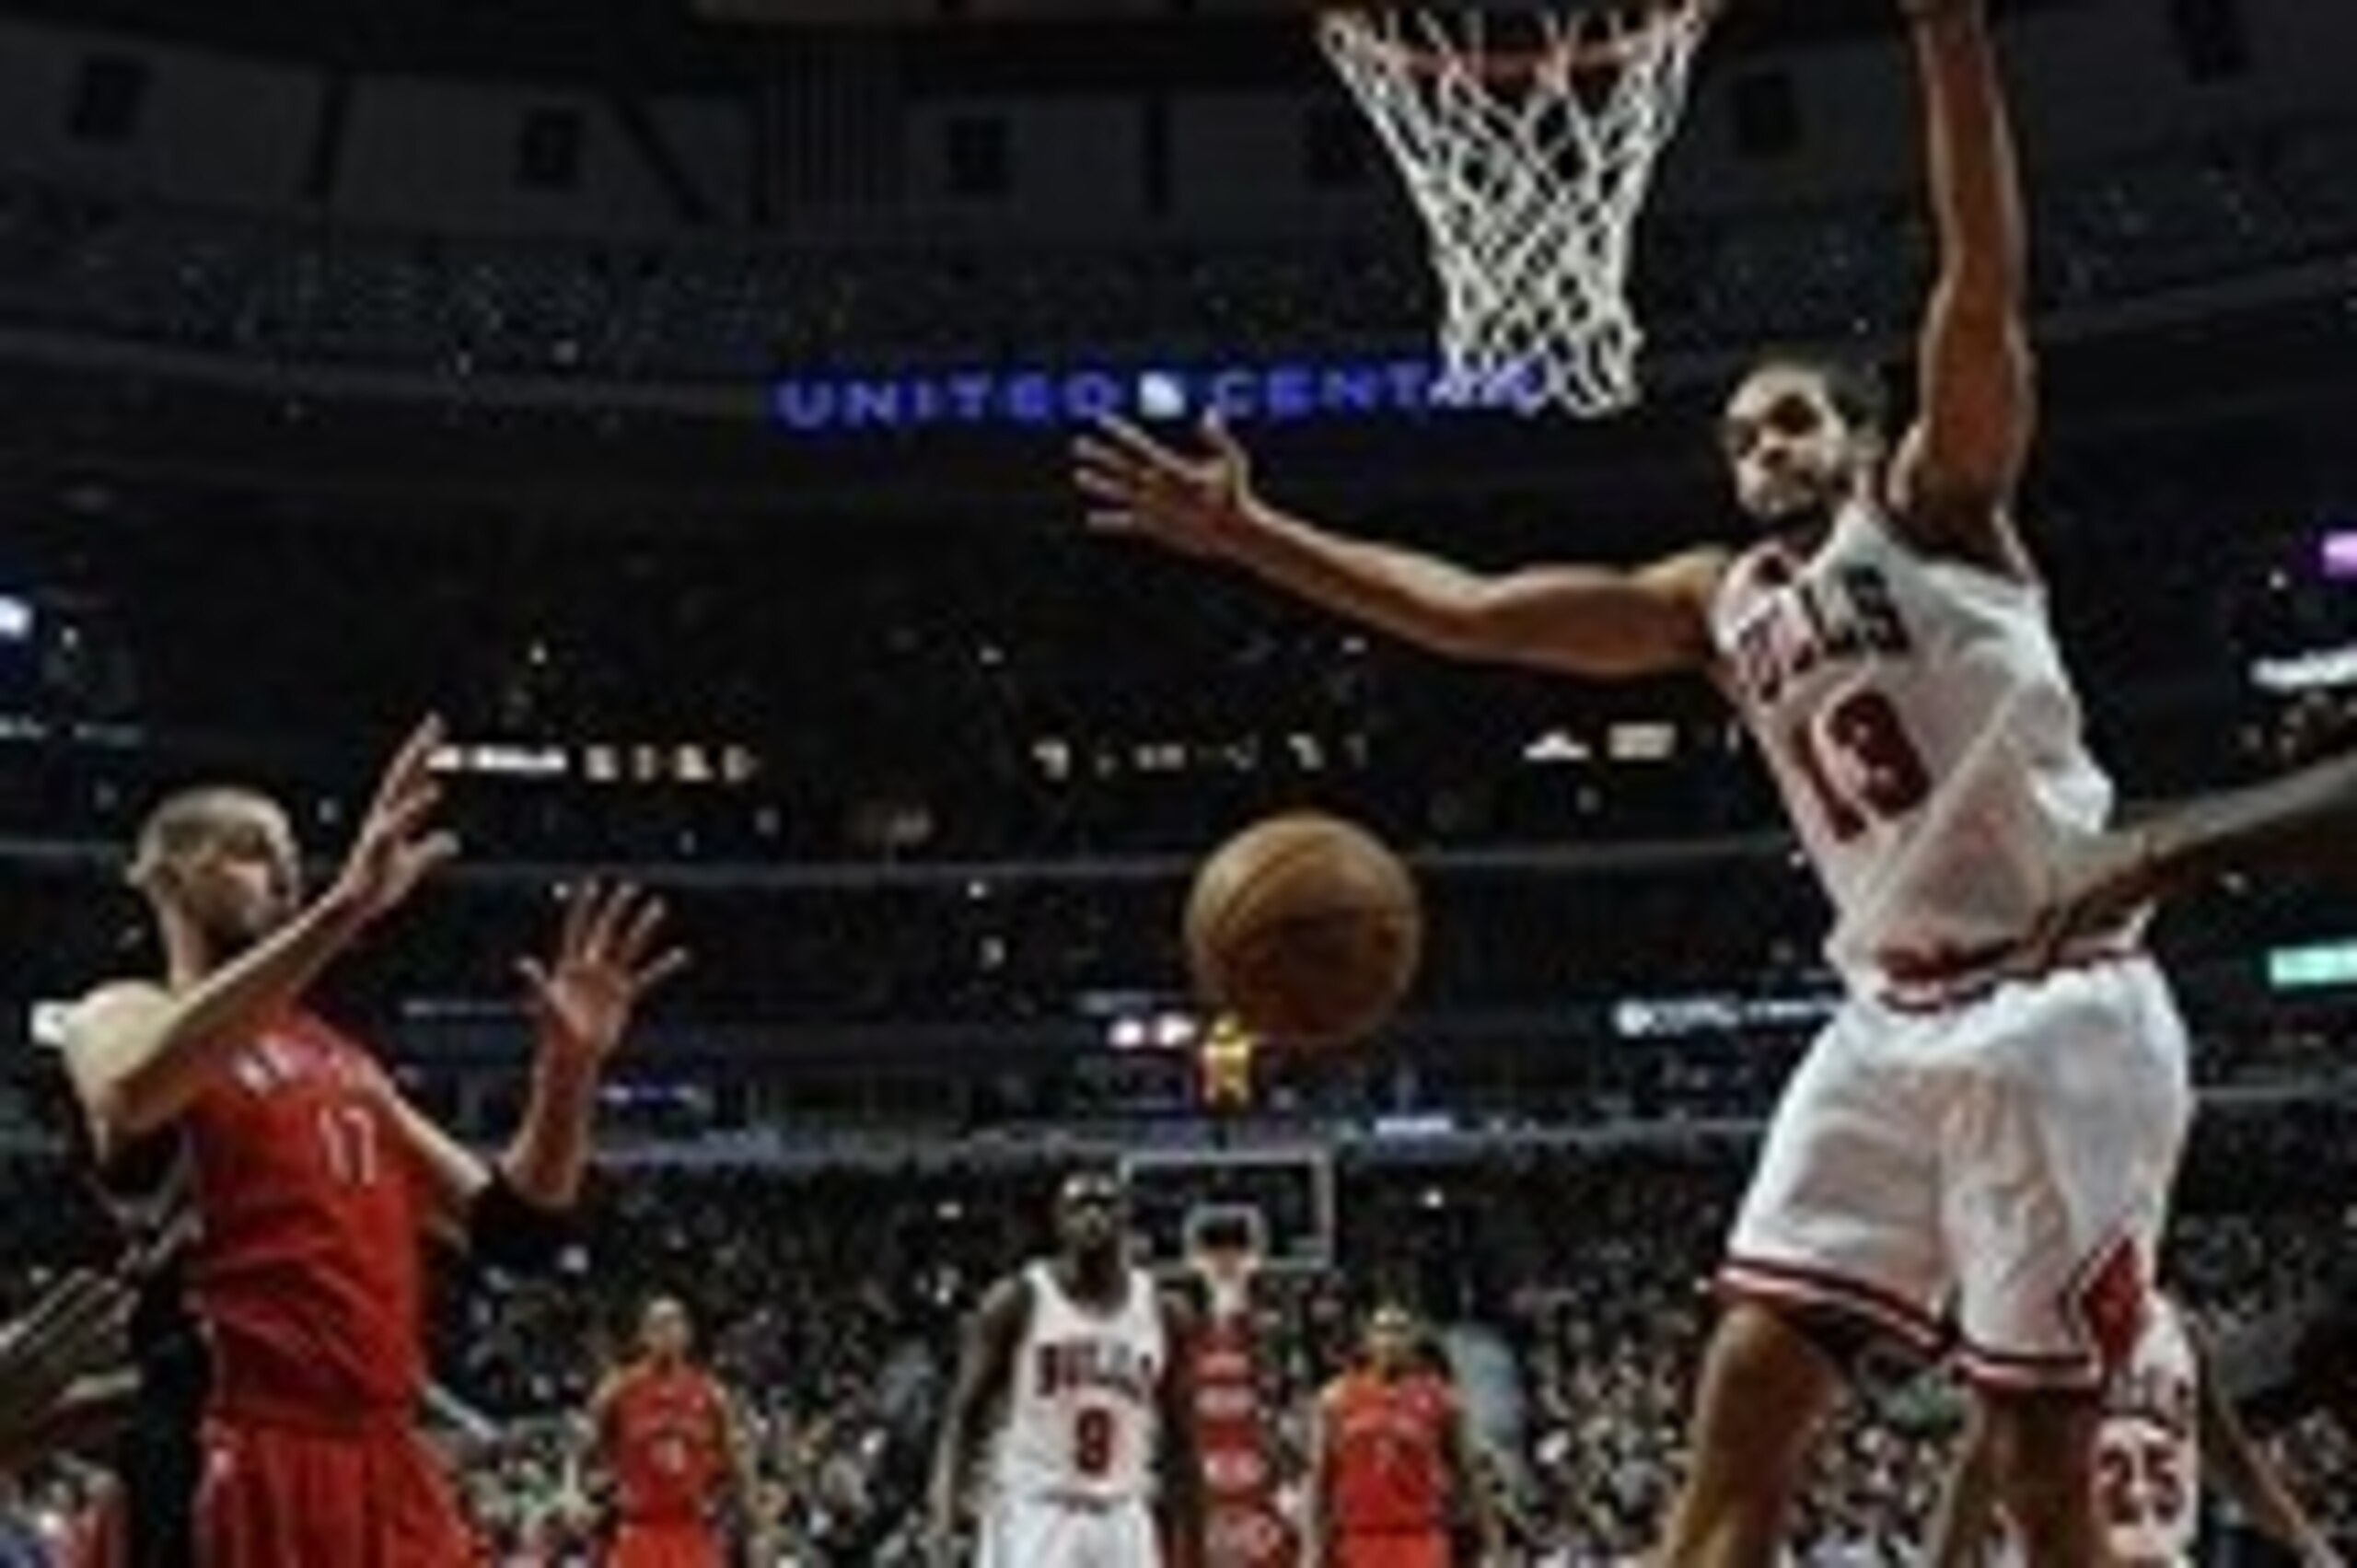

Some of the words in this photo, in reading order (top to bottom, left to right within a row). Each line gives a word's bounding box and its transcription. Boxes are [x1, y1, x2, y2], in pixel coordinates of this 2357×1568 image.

[776, 370, 1121, 428] UNITED
[1212, 357, 1549, 418] CENT
[319, 1106, 377, 1186] 17
[2097, 1443, 2186, 1526] 25
